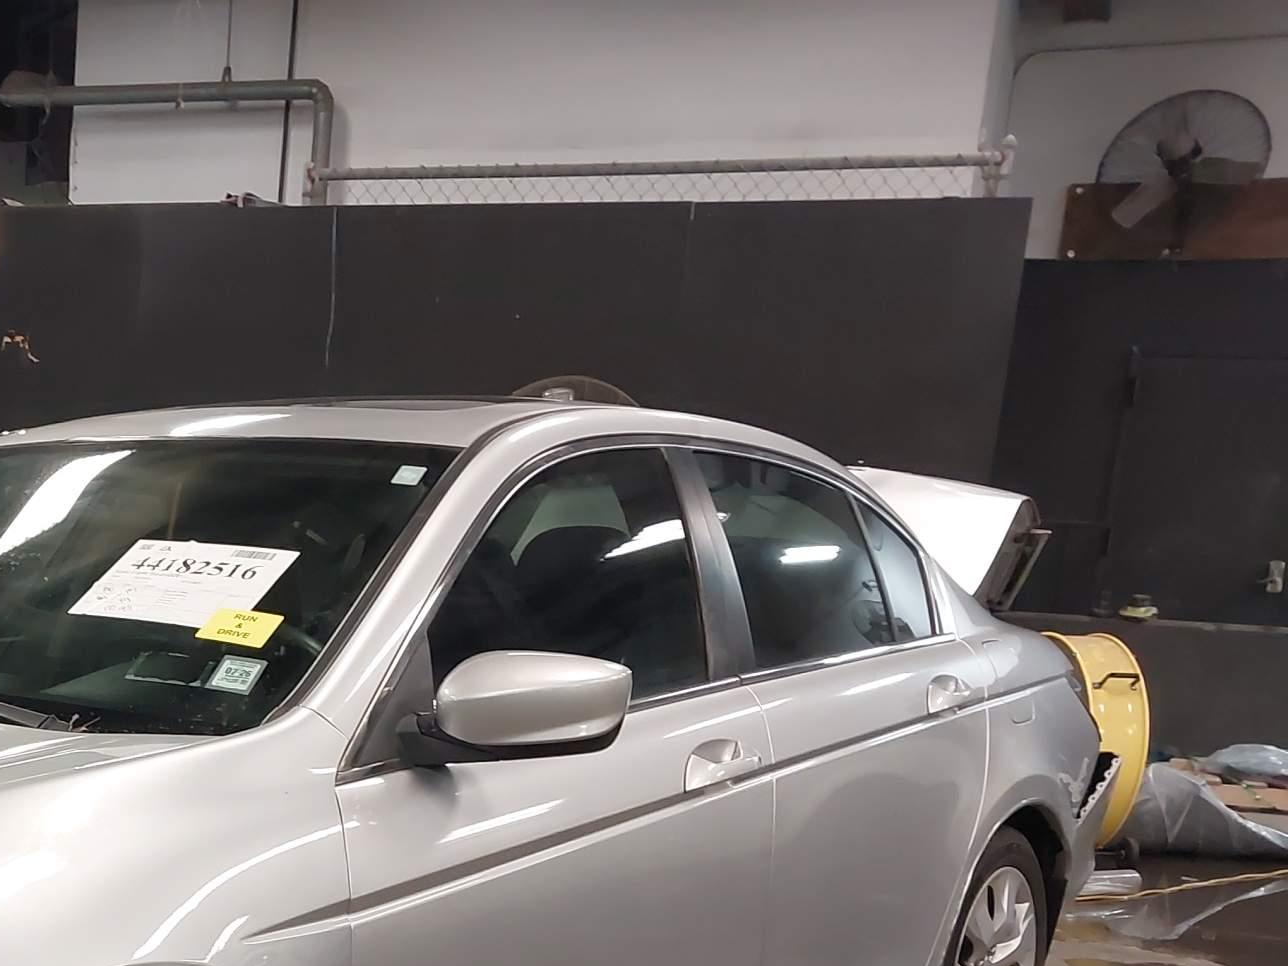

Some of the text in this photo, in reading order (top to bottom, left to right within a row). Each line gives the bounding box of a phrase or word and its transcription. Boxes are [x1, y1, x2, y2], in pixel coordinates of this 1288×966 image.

[132, 556, 264, 580] 44182516
[233, 613, 258, 623] RUN
[216, 628, 251, 639] DRIVE
